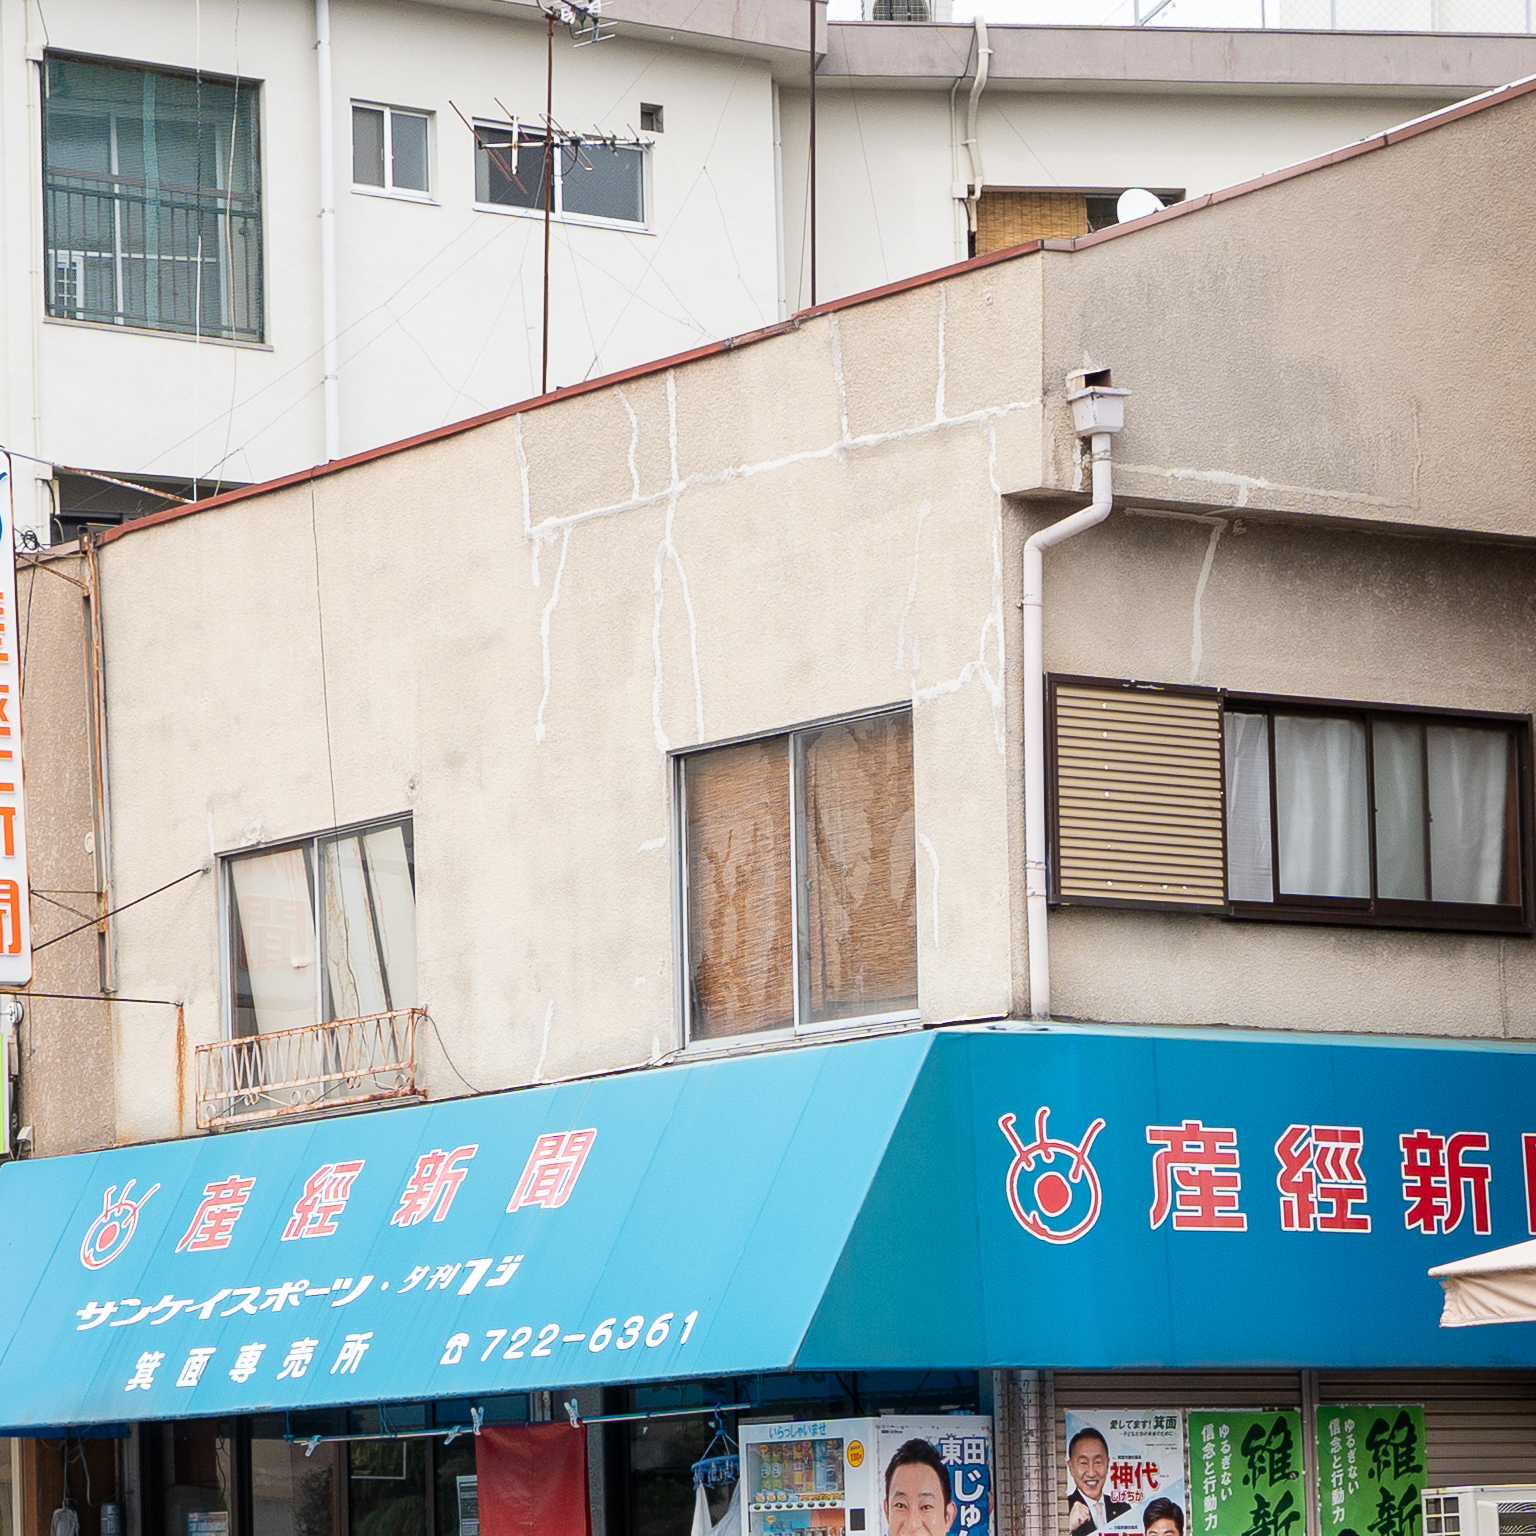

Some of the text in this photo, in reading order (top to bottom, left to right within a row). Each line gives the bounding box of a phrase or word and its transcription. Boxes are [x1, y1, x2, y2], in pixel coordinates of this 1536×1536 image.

[175, 1127, 599, 1255] 産經新聞
[124, 1331, 375, 1392] 箕面専売所
[768, 1423, 827, 1440] いらっしゃいませ
[939, 1436, 986, 1466] 東田
[1218, 1423, 1233, 1502] ゆるぎない
[1344, 1418, 1360, 1495] ゆるぎない
[1110, 1461, 1159, 1490] 神代
[1201, 1423, 1218, 1532] 信念と行動力
[1328, 1417, 1346, 1525] 信念と行動力
